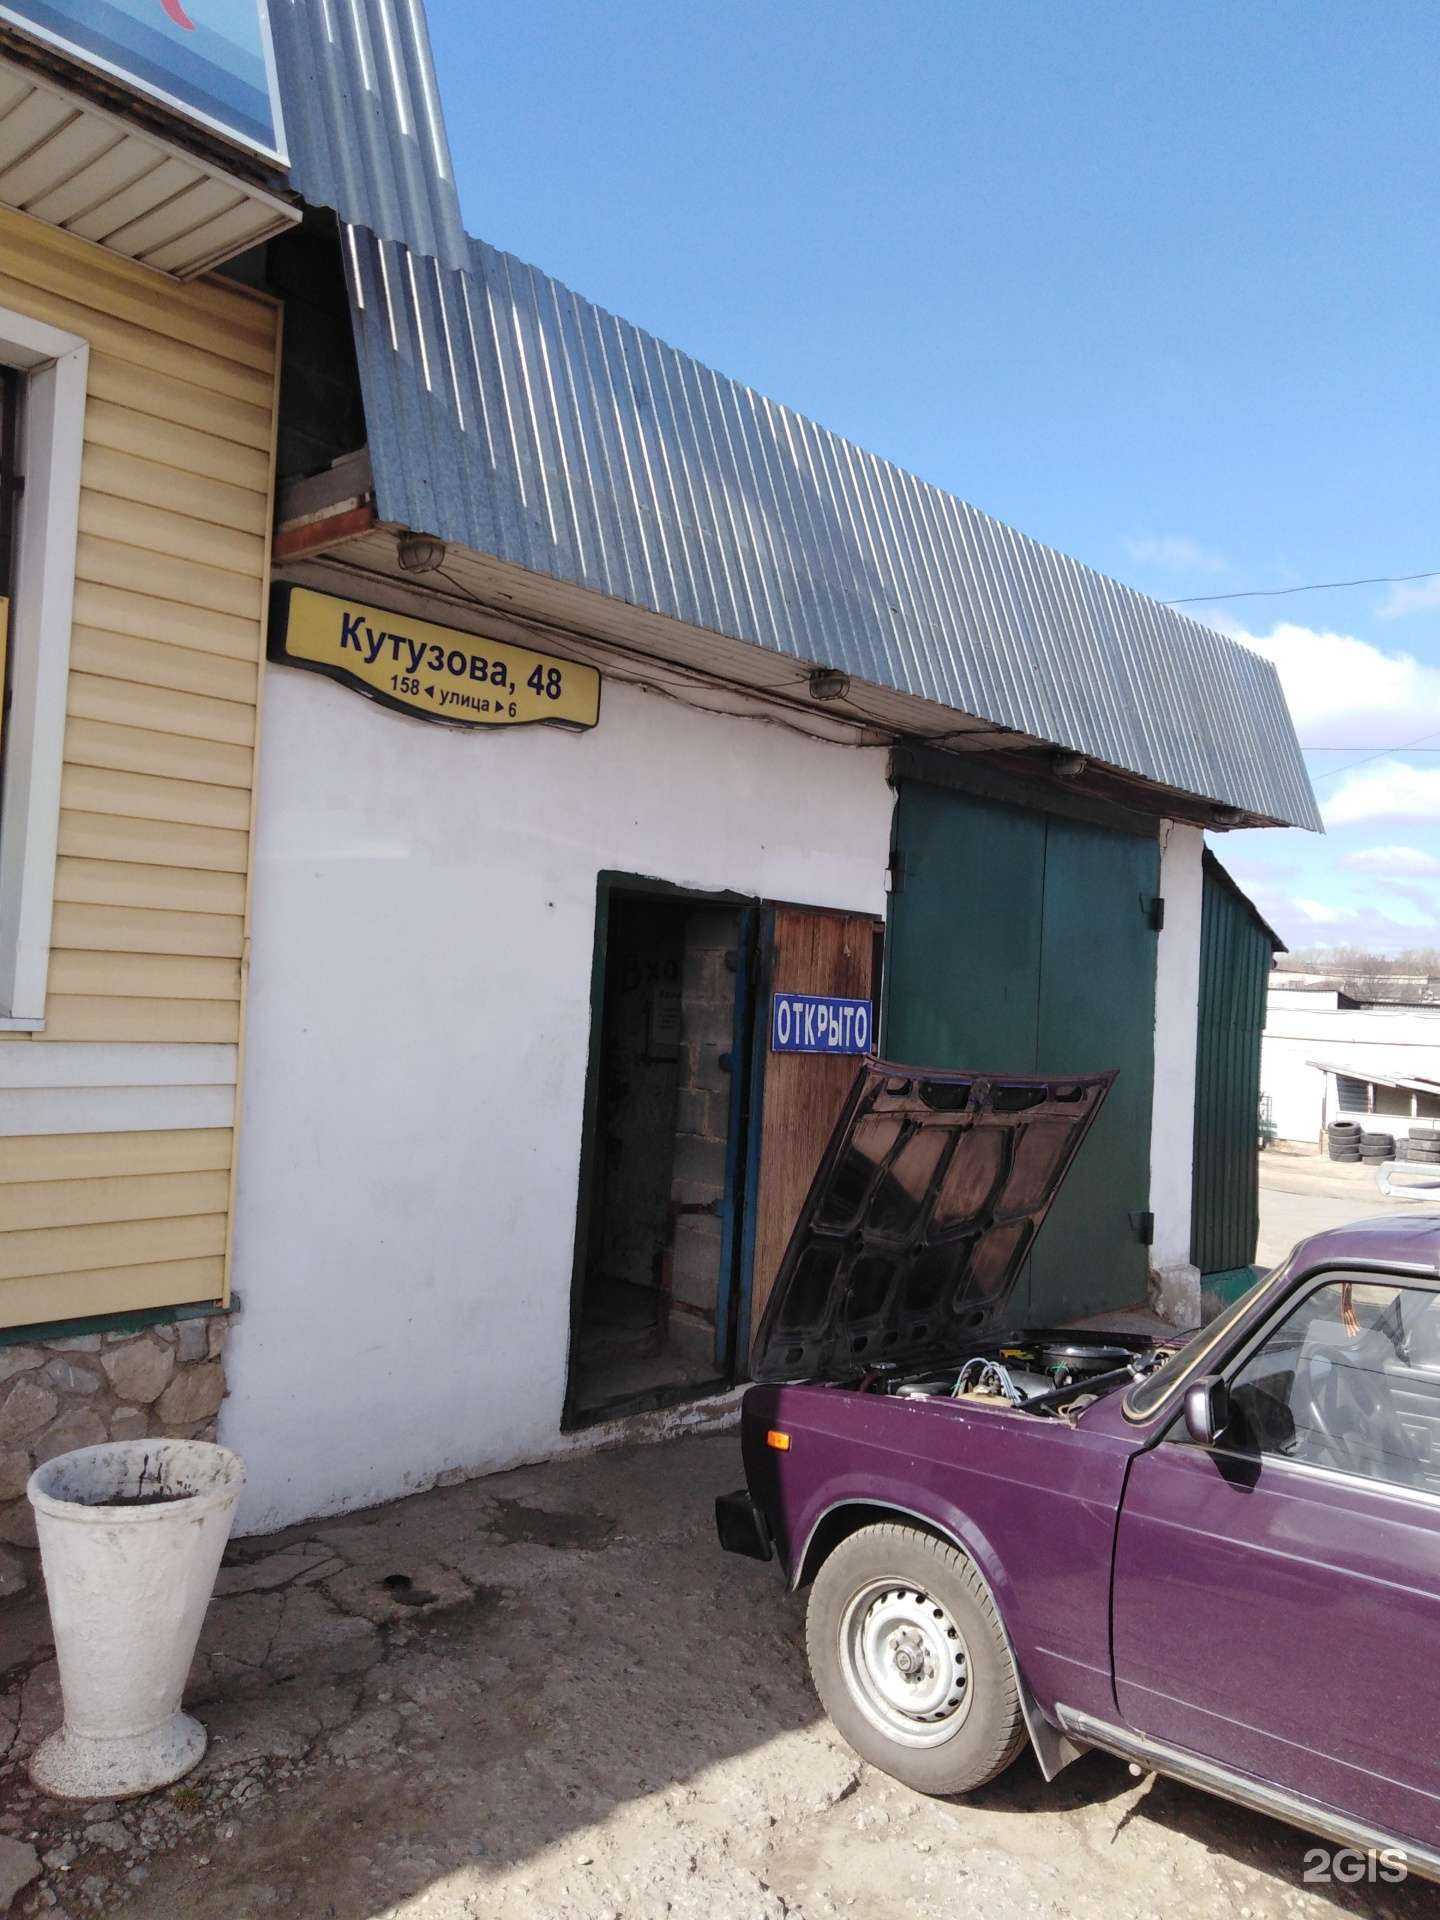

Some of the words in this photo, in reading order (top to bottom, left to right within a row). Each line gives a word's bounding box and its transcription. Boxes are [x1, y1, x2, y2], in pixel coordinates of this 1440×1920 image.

[340, 612, 515, 695] Кутузова,
[527, 664, 562, 700] 48
[391, 674, 420, 696] 158
[439, 689, 490, 712] улица
[508, 702, 517, 718] 6
[777, 1000, 868, 1048] ОТКРЫТО
